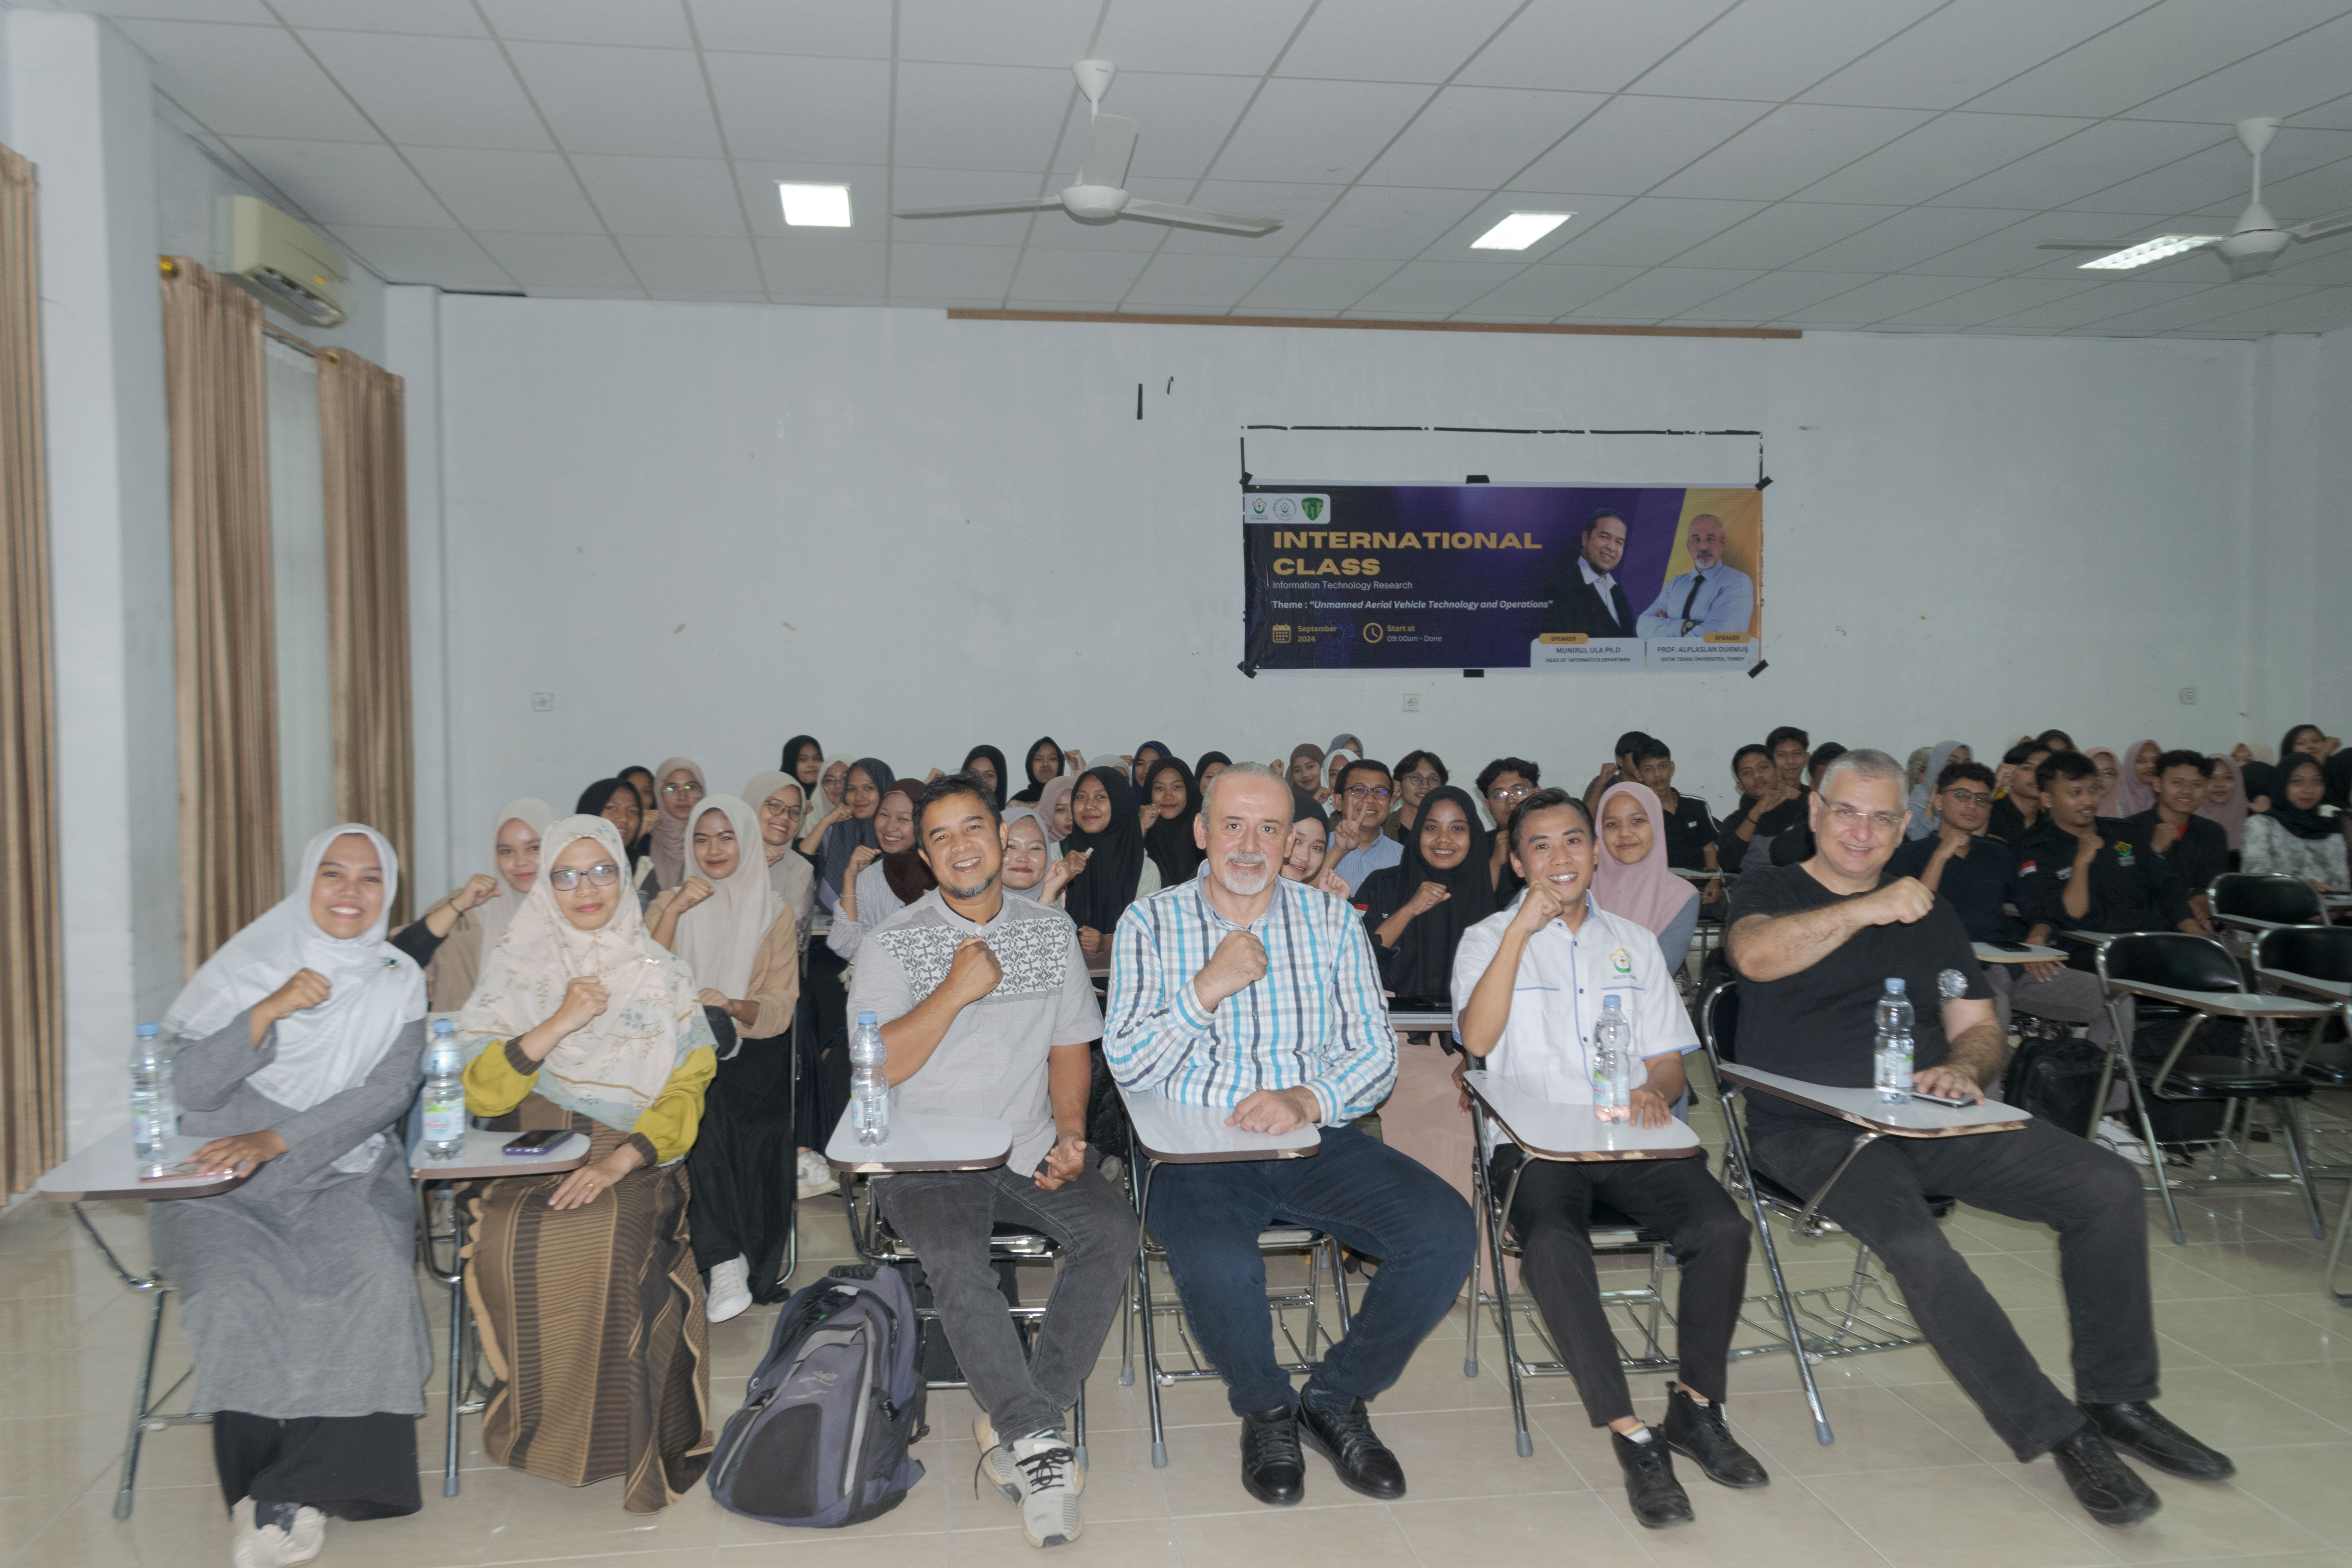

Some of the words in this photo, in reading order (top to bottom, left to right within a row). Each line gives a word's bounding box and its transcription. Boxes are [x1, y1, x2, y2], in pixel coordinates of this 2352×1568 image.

[1274, 531, 1543, 549] INTERNATIONAL
[1273, 558, 1380, 575] CLASS
[1322, 581, 1371, 591] Technology
[1374, 581, 1412, 589] Research
[1428, 600, 1479, 610] Technology
[1480, 600, 1498, 608] and
